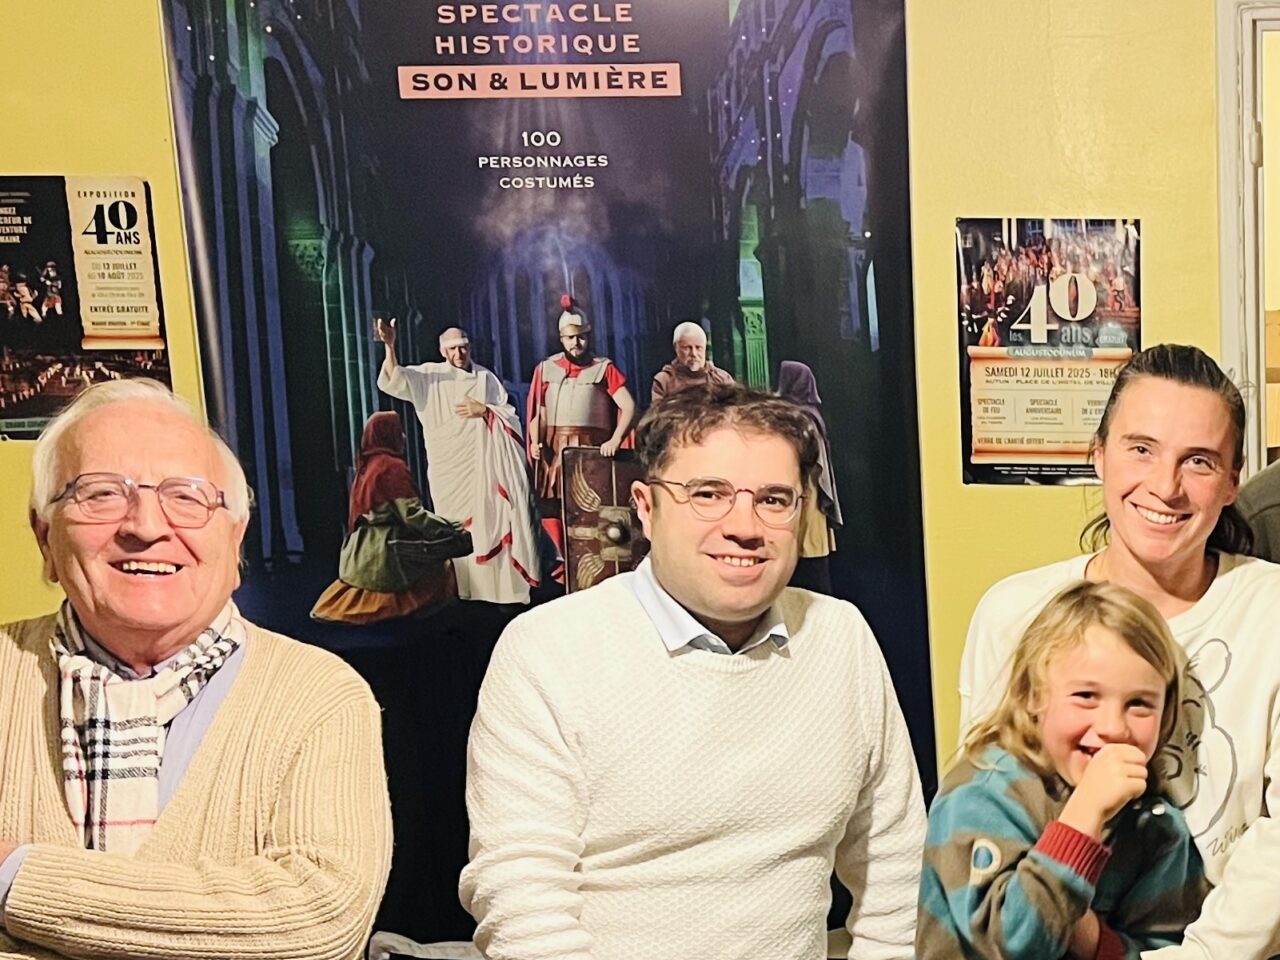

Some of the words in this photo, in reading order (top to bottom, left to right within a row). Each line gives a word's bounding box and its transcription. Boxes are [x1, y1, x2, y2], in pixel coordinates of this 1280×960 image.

[437, 3, 633, 25] SPECTACLE
[434, 34, 641, 55] HISTORIQUE
[411, 73, 477, 91] SON
[489, 73, 508, 91] &
[520, 66, 668, 90] LUMIÈRE
[521, 131, 561, 147] 100
[478, 155, 609, 169] PERSONNAGES
[499, 174, 595, 189] COSTUMÉS
[77, 190, 136, 198] EXPOSITION
[82, 200, 138, 245] 40
[115, 231, 141, 245] ANS
[90, 304, 114, 313] ENTRÉE
[116, 305, 149, 313] GRATUITE
[1010, 272, 1097, 344] 40
[1061, 323, 1093, 343] ans
[985, 366, 1018, 378] SAMEDI
[1020, 367, 1031, 378] 12
[1033, 367, 1064, 378] JUILLET
[1067, 367, 1091, 379] 2025
